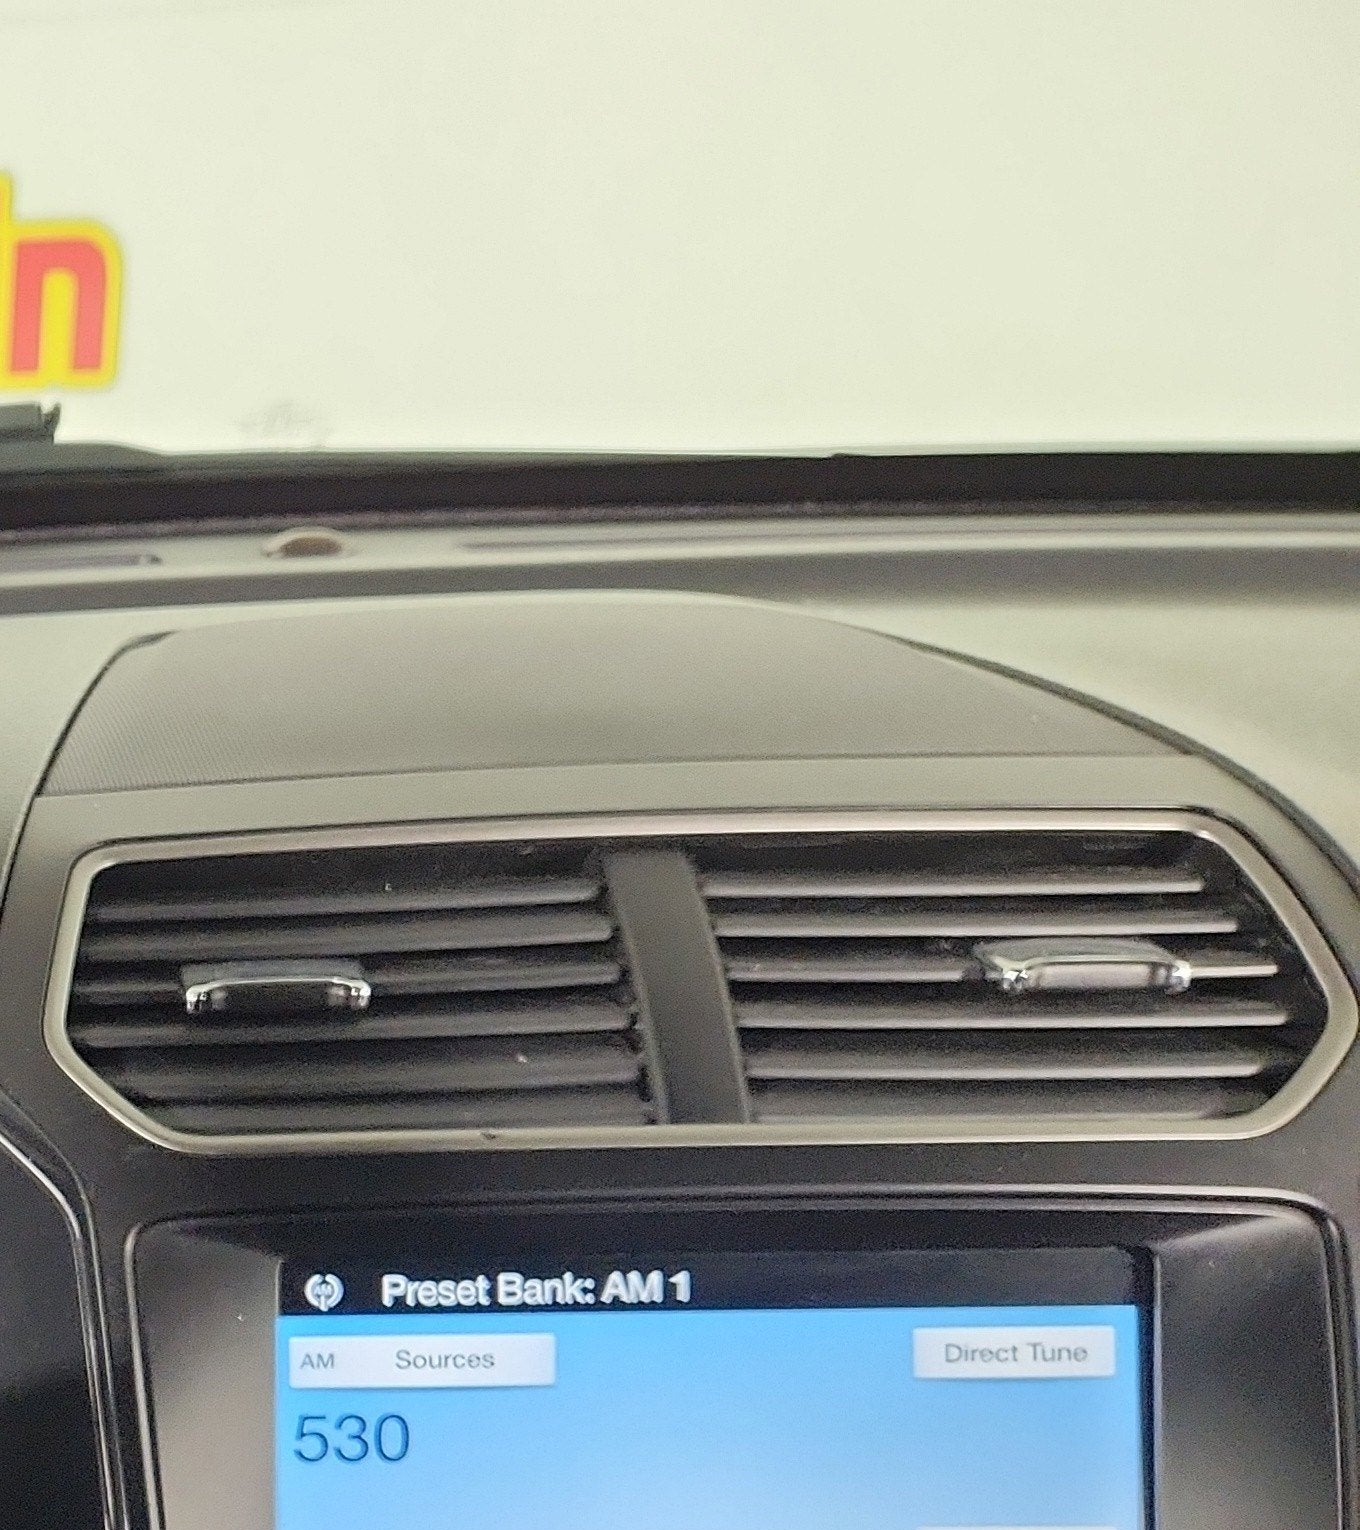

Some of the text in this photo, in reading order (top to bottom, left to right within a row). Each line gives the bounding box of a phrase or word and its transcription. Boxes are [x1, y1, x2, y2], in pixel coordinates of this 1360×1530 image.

[381, 1270, 692, 1308] Preset Bank: AM 1
[299, 1353, 336, 1371] AM
[394, 1349, 497, 1371] Sources
[945, 1342, 1088, 1364] Direct Tune
[293, 1413, 410, 1463] 530
